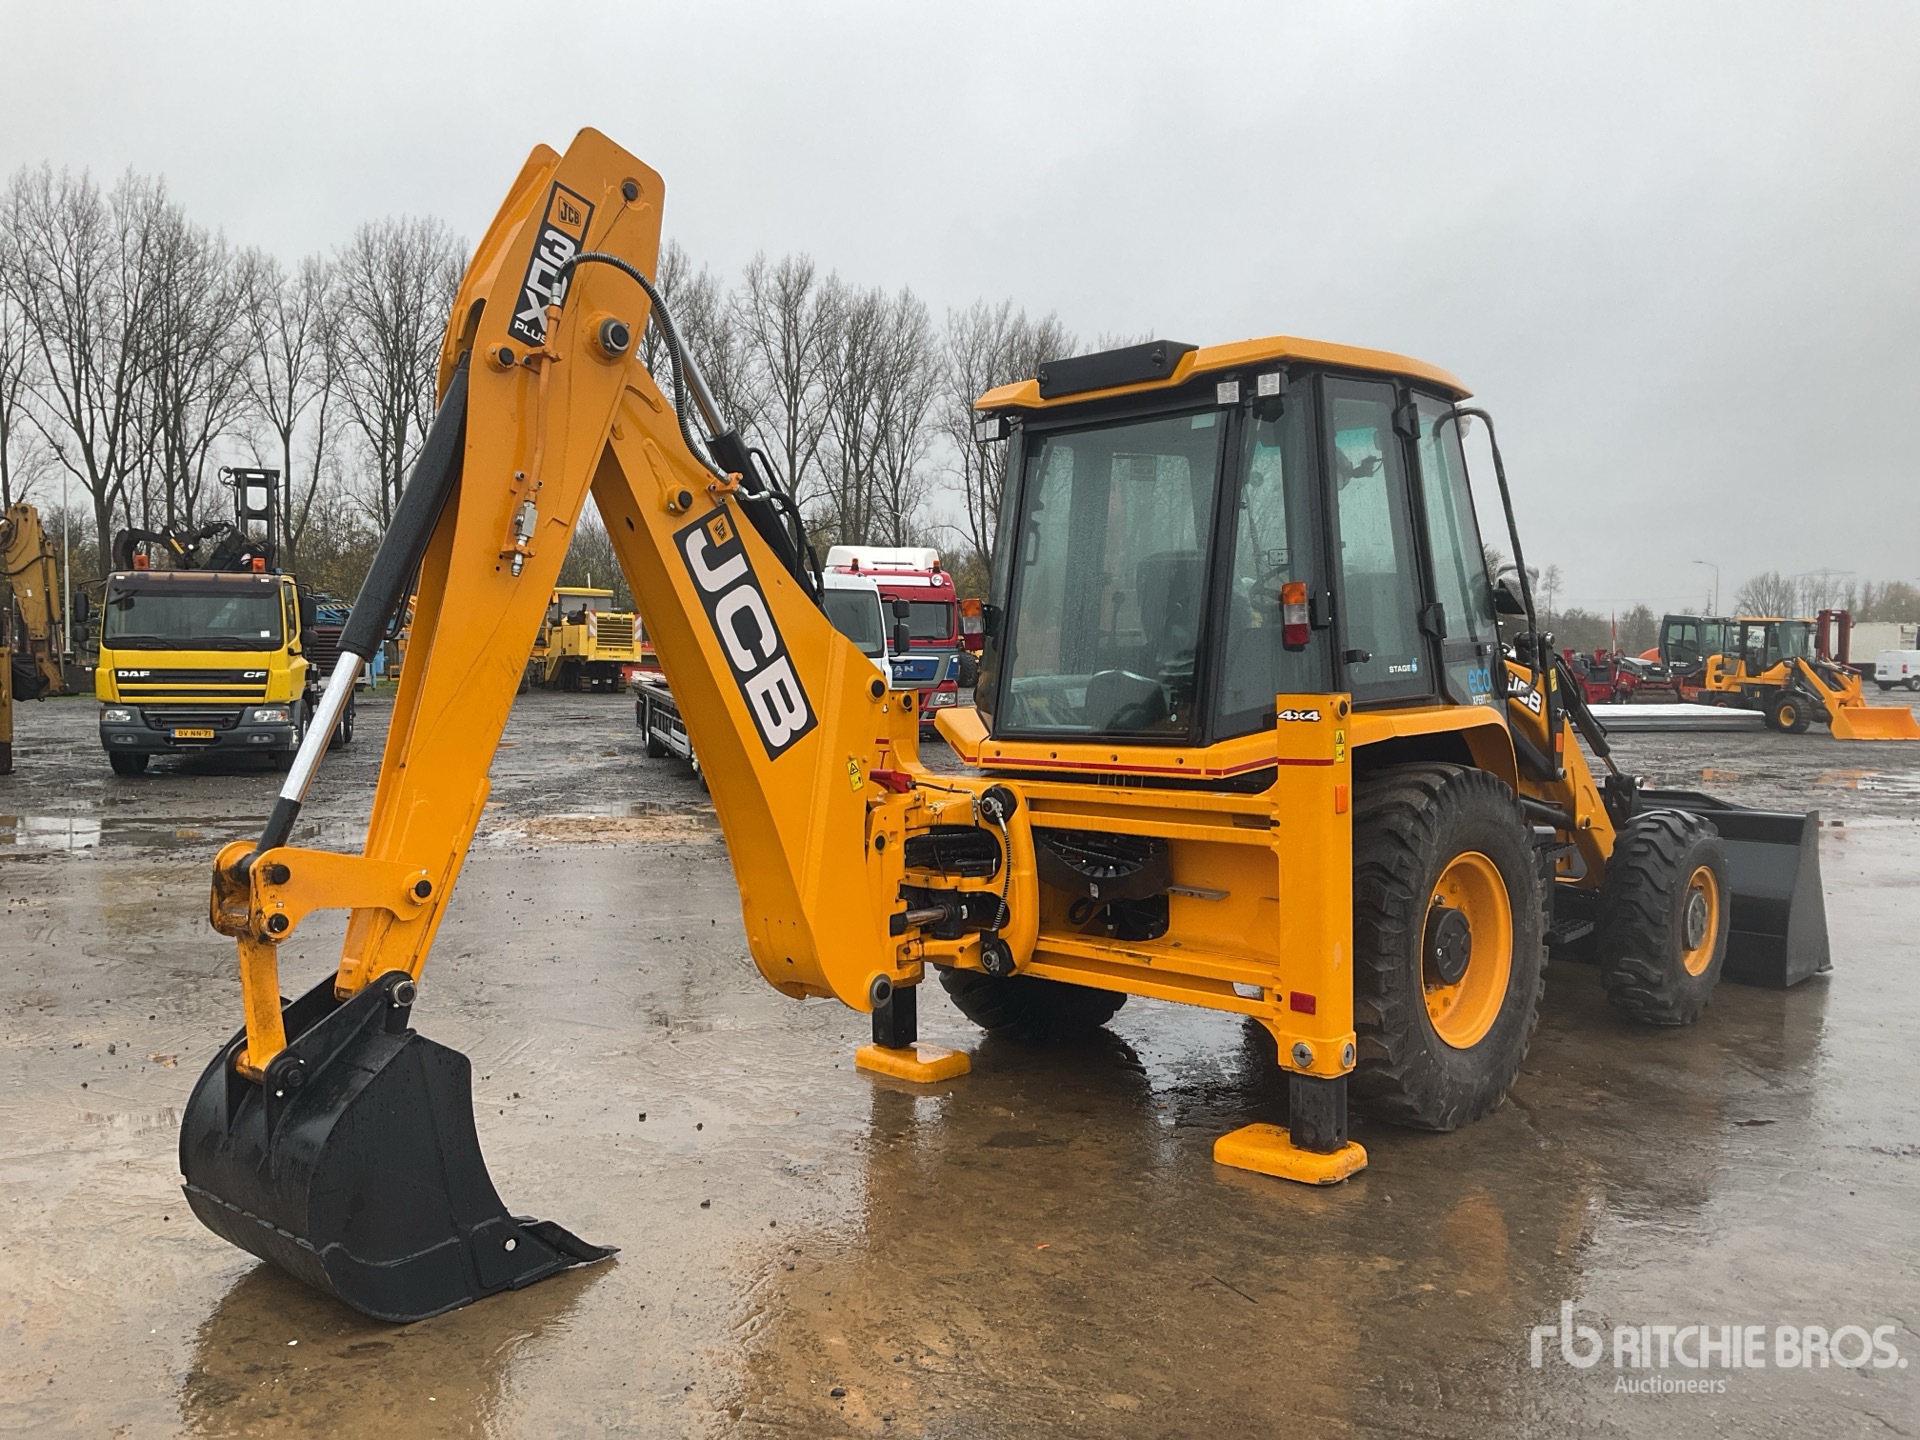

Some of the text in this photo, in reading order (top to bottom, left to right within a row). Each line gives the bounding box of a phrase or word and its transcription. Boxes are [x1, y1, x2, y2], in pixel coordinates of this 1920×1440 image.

[560, 202, 580, 225] JCB
[714, 522, 727, 540] JCB
[685, 527, 808, 747] JCB
[1388, 664, 1411, 674] STAGE
[1467, 667, 1491, 693] eco
